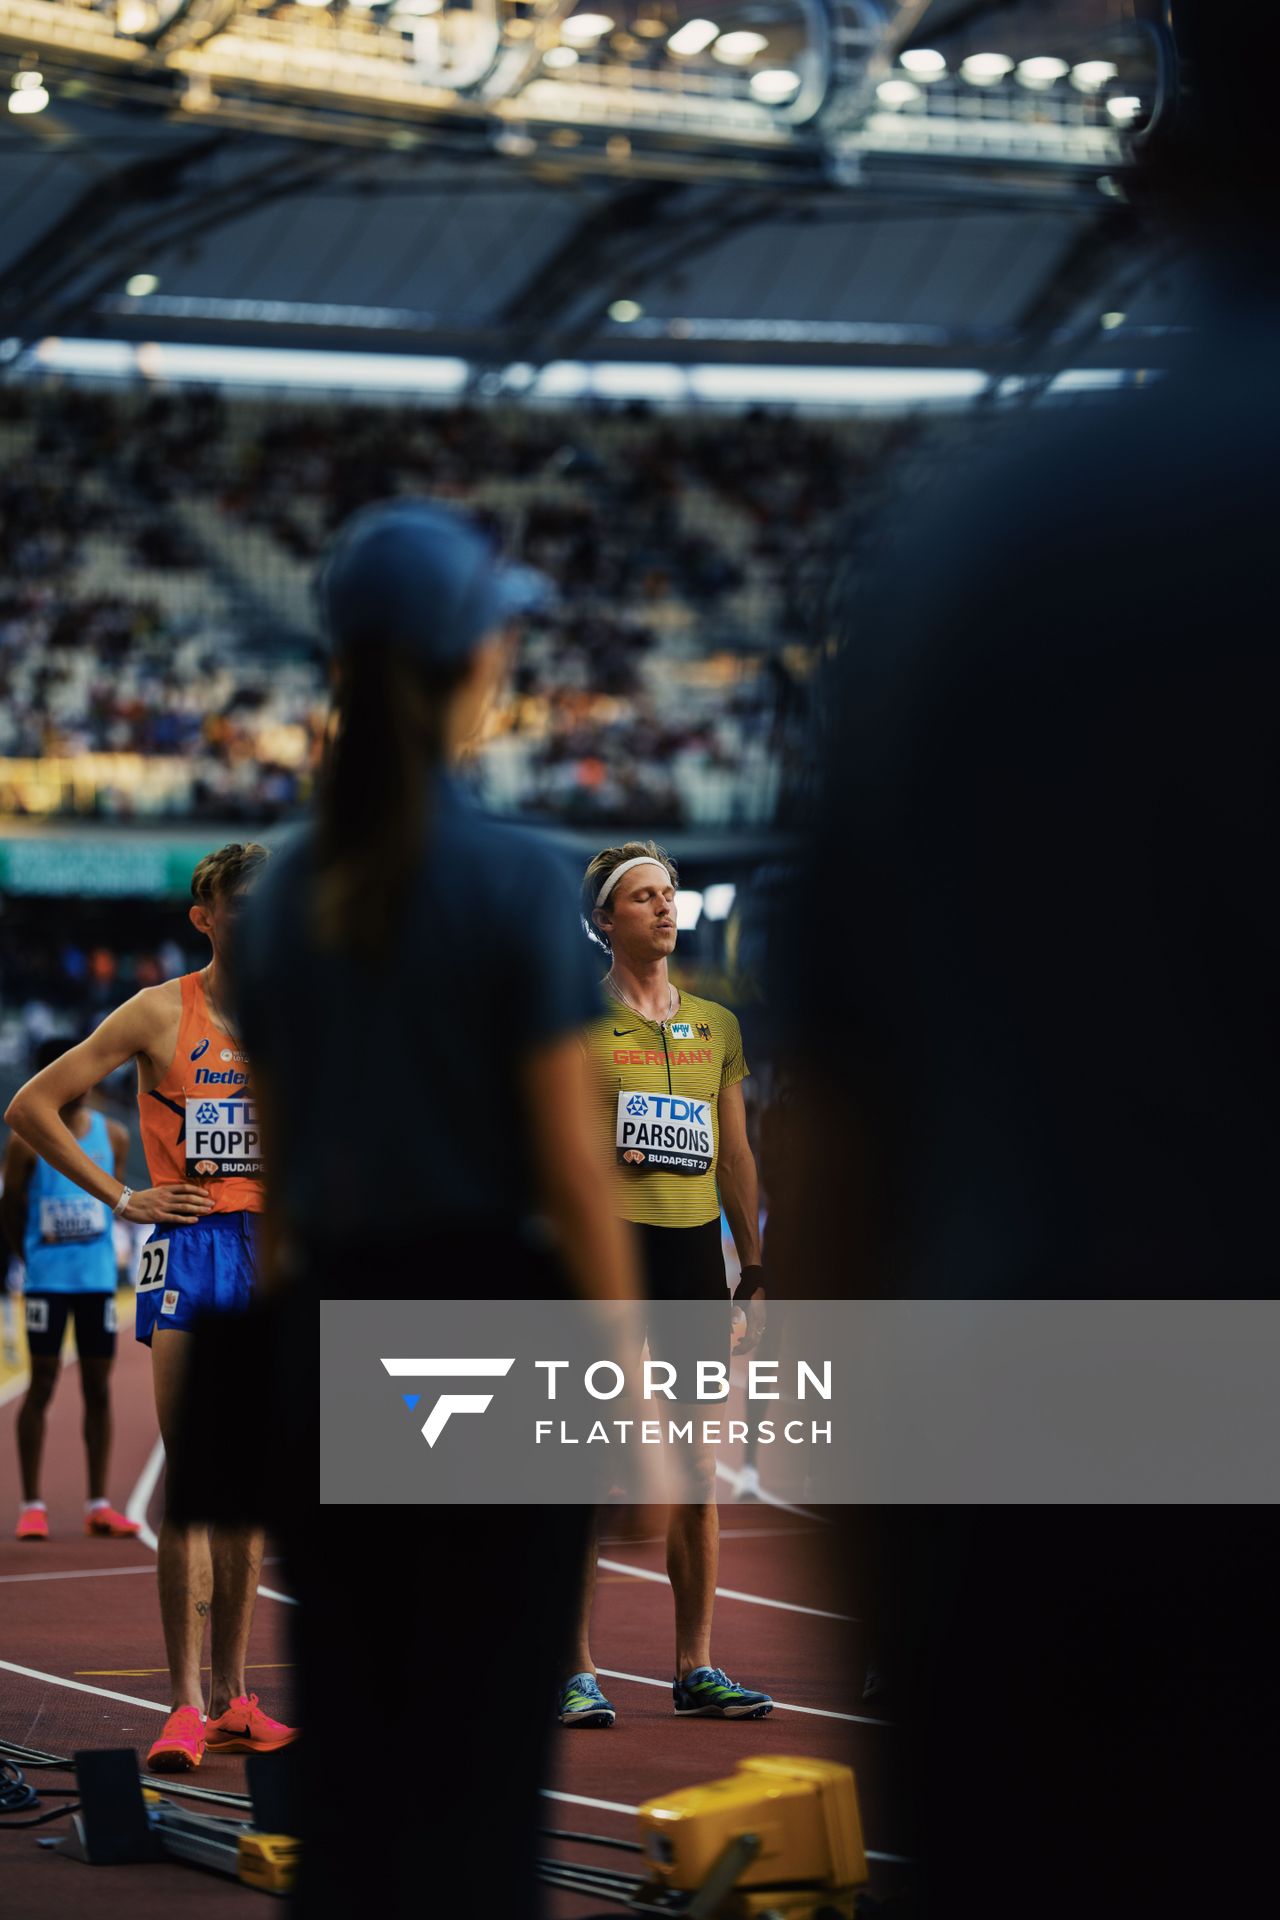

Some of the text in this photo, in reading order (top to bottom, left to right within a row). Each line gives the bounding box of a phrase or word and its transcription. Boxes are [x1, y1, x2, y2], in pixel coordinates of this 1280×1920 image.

[612, 1049, 712, 1066] GERMANY
[648, 1096, 706, 1126] TDK
[195, 1131, 264, 1155] FOPP
[622, 1121, 710, 1154] PARSONS
[648, 1154, 708, 1170] BUDAPEST 23
[140, 1247, 165, 1286] 22
